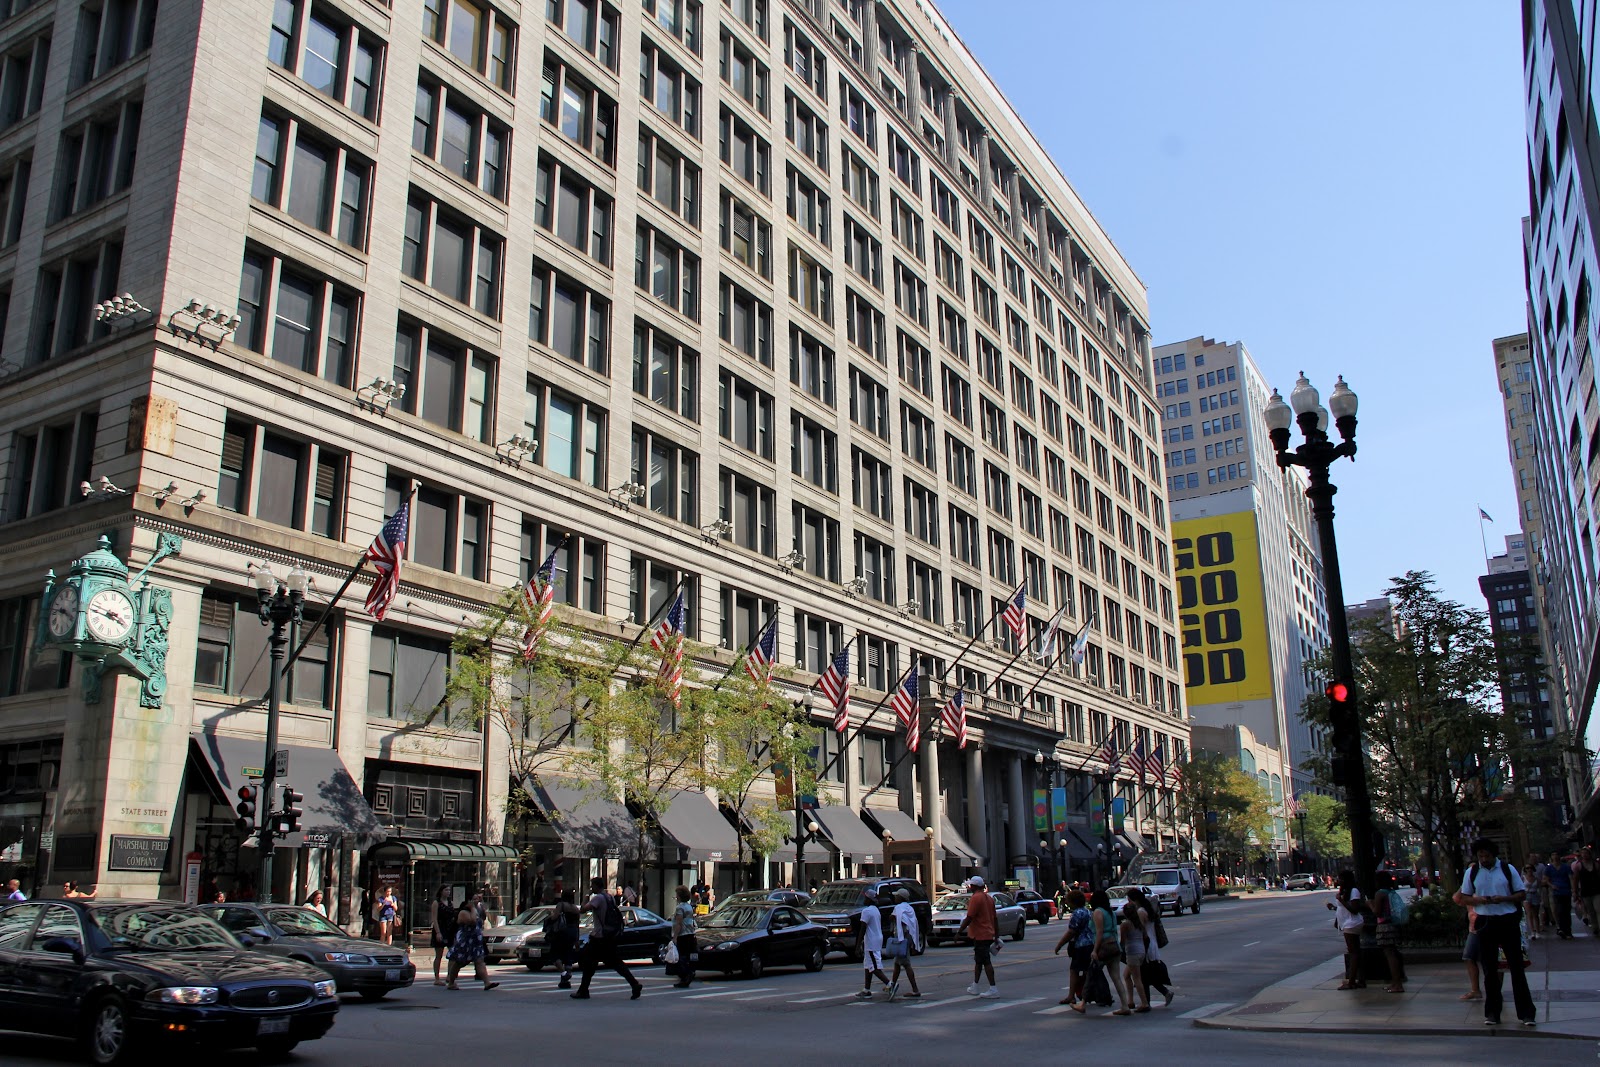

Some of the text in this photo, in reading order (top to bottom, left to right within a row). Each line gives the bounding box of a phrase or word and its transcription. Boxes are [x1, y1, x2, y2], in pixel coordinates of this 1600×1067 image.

[116, 838, 168, 850] MARSHALL FIELD
[126, 857, 158, 866] COMPANY
